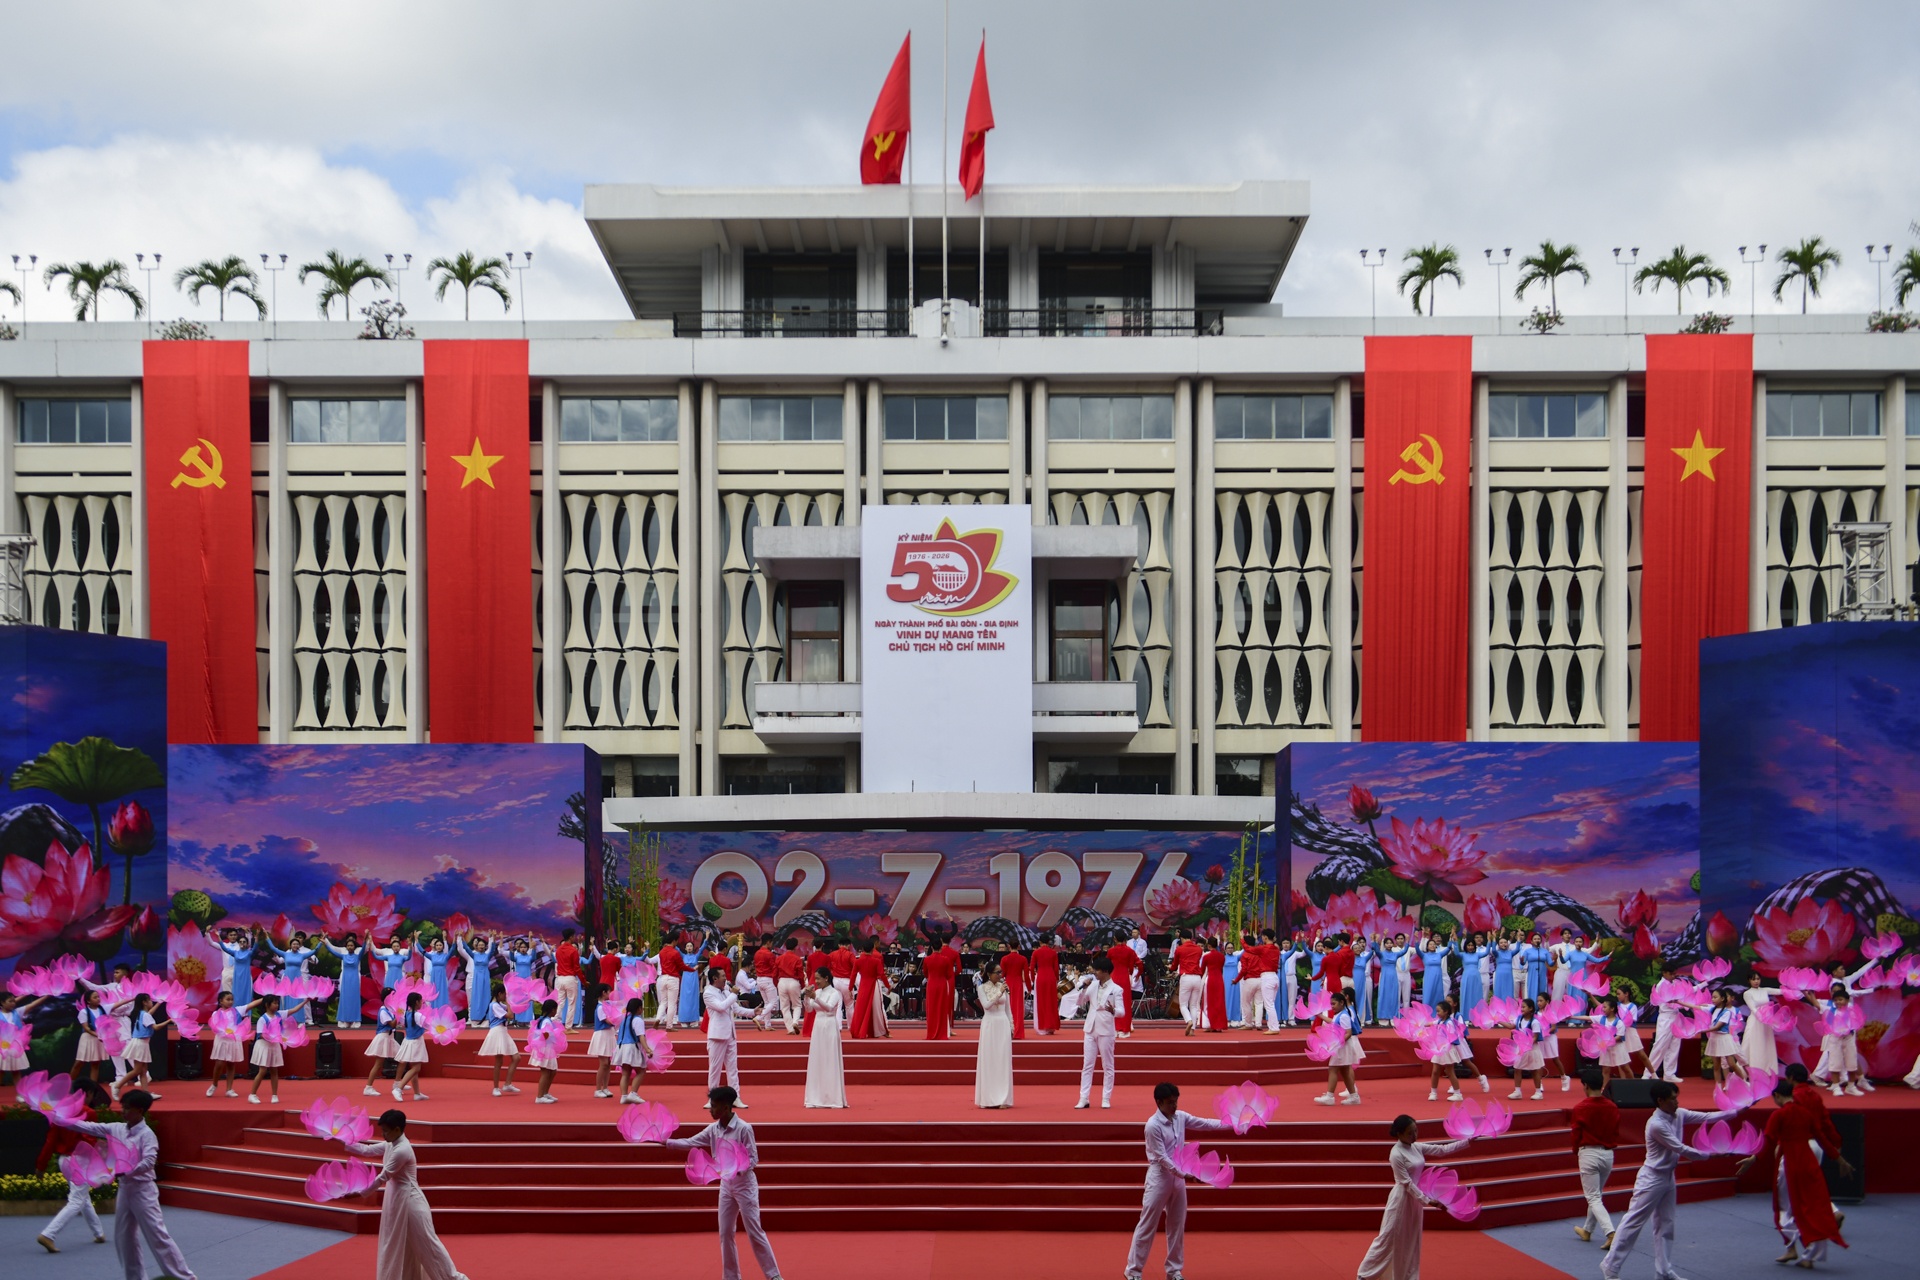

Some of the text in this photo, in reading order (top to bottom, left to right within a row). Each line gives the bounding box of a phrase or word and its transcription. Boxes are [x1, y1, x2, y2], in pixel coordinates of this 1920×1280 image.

[911, 534, 932, 542] NIỆM
[886, 542, 979, 603] 50
[928, 619, 943, 627] PHỐ
[897, 629, 997, 640] VINH DỰ MANG TÊN
[889, 640, 1005, 653] CHỦ TỊCH HỒ CHÍ MINH
